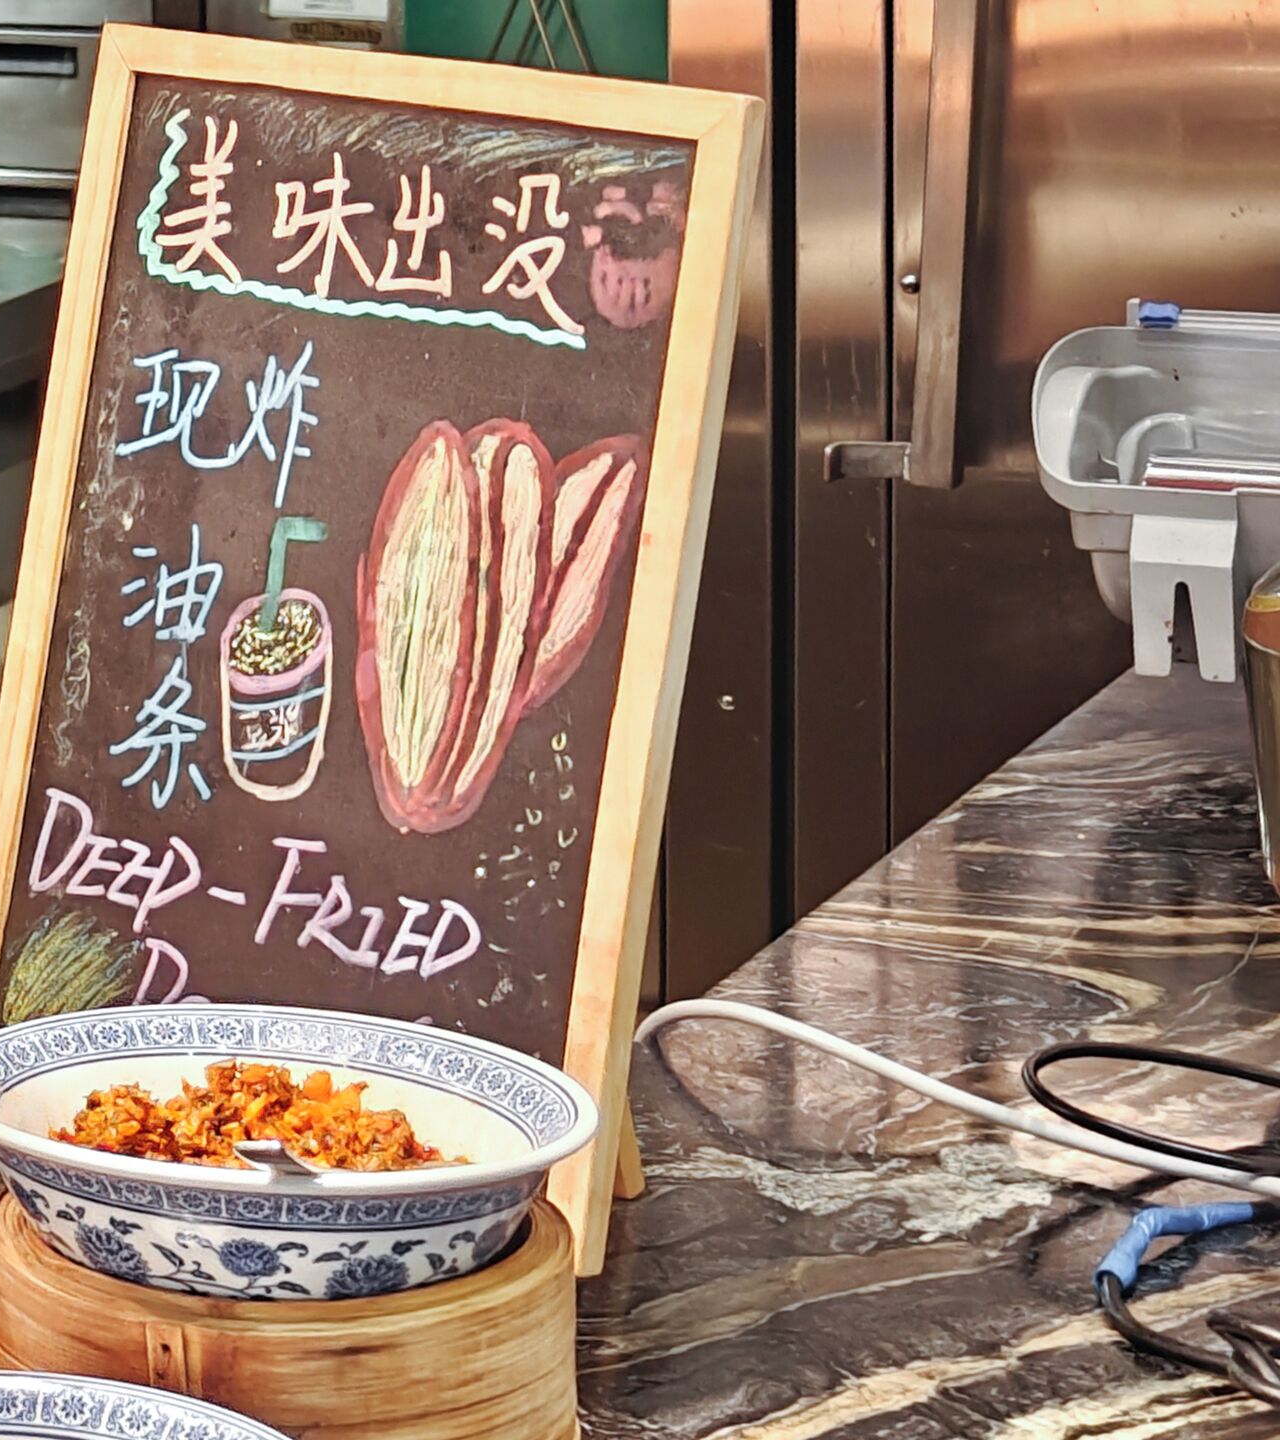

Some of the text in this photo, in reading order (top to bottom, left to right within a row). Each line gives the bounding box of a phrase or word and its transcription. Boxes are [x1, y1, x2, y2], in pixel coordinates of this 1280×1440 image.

[155, 115, 585, 335] 美味出没
[115, 340, 321, 509] 现炸
[109, 523, 224, 810] 油条
